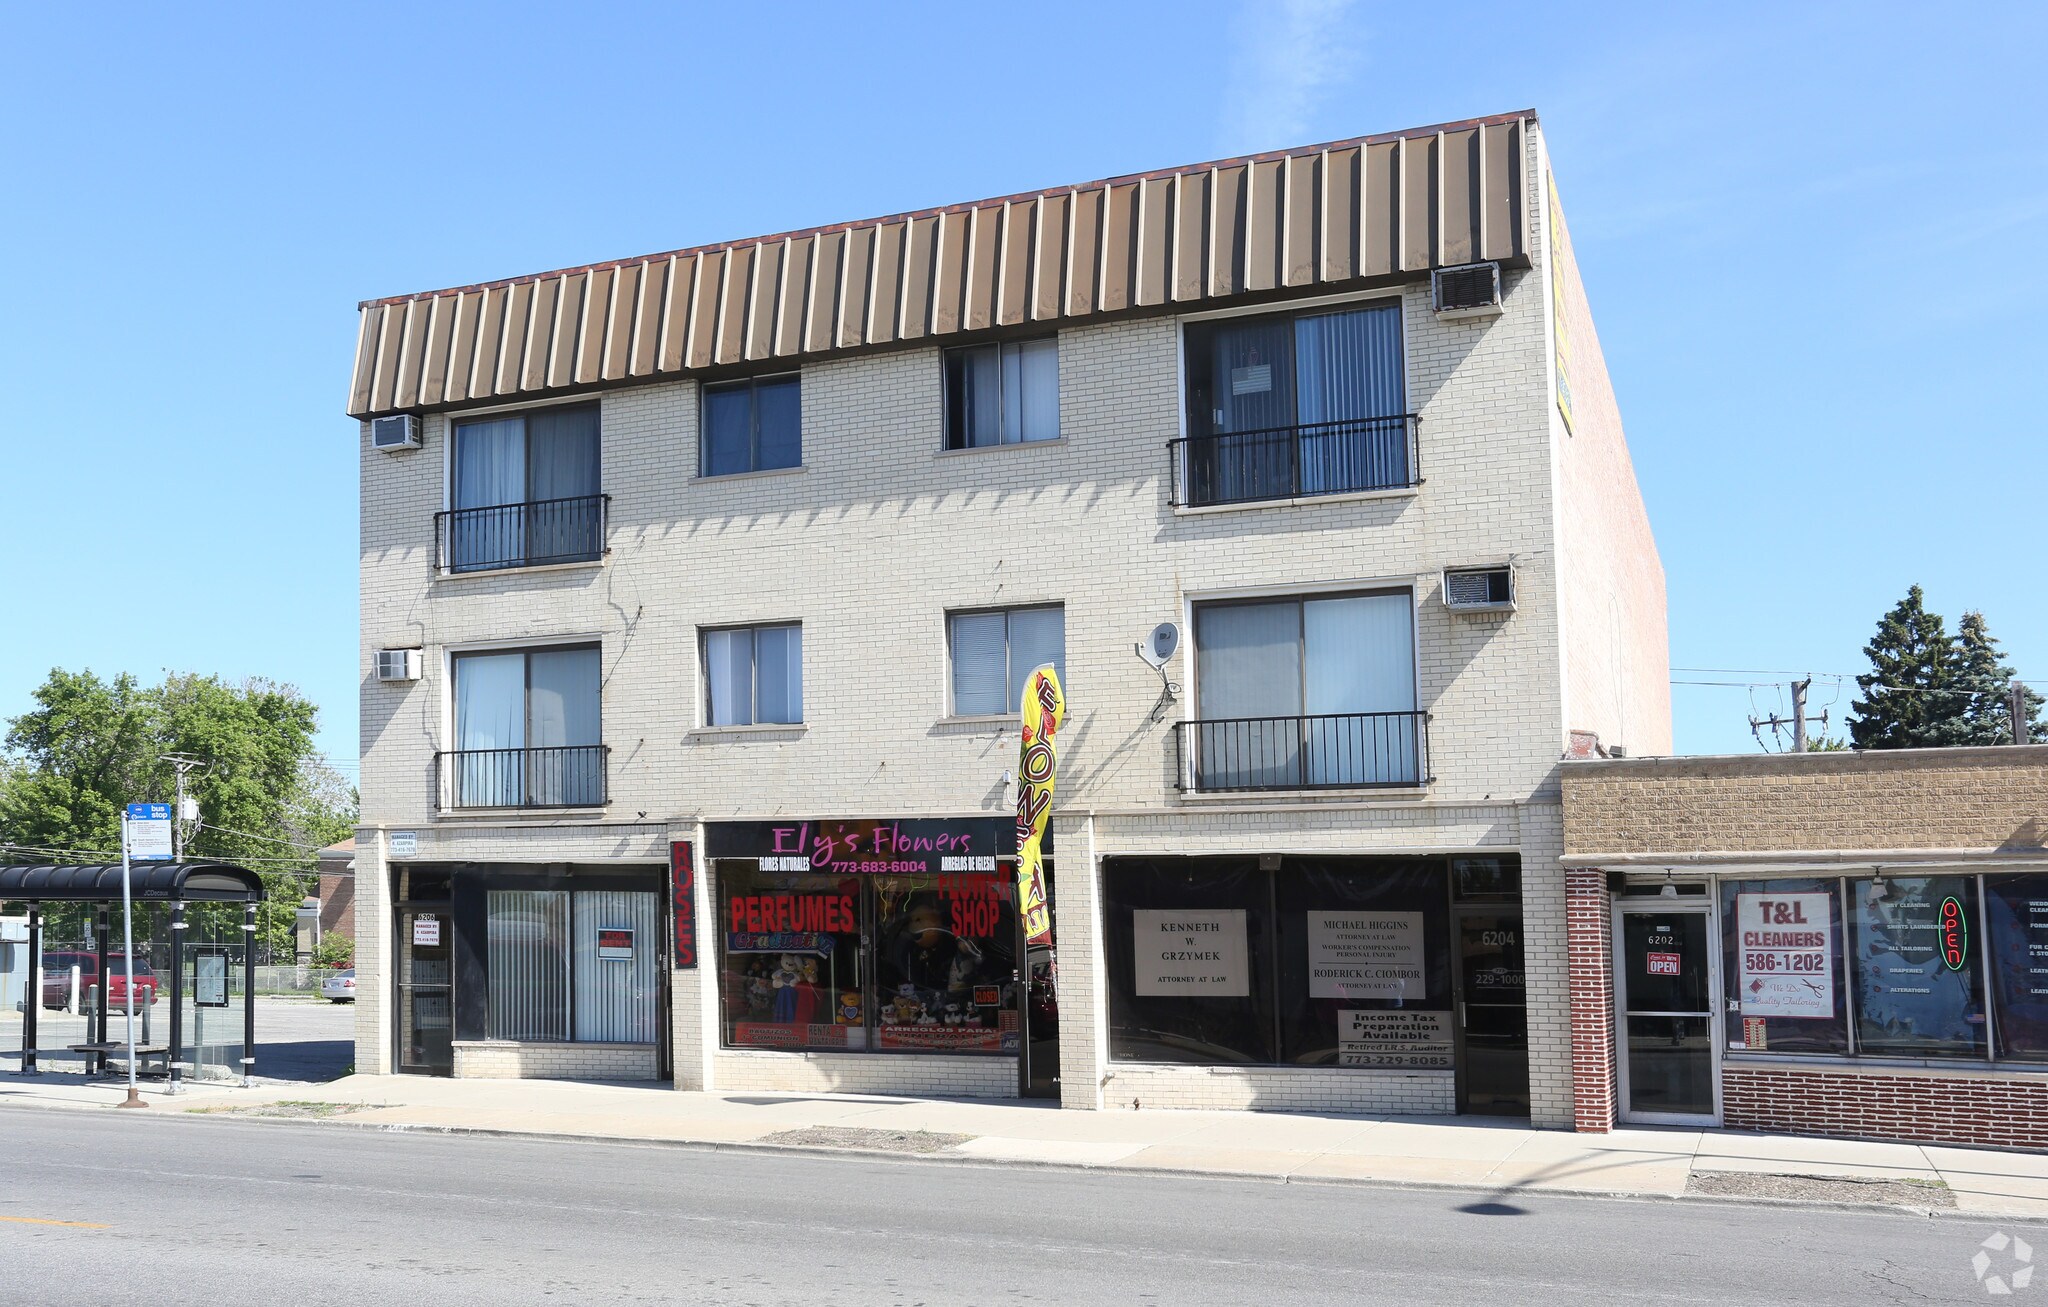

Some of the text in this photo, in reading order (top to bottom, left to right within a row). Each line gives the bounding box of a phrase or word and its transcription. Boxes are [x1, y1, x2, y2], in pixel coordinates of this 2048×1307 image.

[151, 811, 168, 819] stop
[872, 822, 972, 854] Flowers
[771, 822, 860, 867] Ely's
[759, 856, 810, 872] FLORES NATURALES
[831, 861, 927, 873] 773-683-6004
[941, 856, 996, 871] ARREGLOS DE IGLESIA
[938, 865, 1011, 900] FLOWER
[673, 842, 693, 965] ROSES
[418, 913, 435, 921] 6206
[731, 895, 854, 934] PERFUMES
[1759, 900, 1808, 924] T&L
[951, 900, 999, 938] SHOP
[1160, 923, 1220, 932] KENNETH
[1323, 920, 1409, 930] MICHAEL HIGGINS
[606, 931, 626, 939] FOR
[1943, 902, 1961, 963] OPEN
[600, 939, 632, 947] RENT
[735, 932, 834, 953] Graduati
[1185, 937, 1197, 946] W.
[1482, 931, 1516, 946] 6204
[1648, 935, 1674, 944] 6202
[1744, 930, 1825, 947] CLEANERS
[1161, 952, 1221, 960] GRZYMEK
[1650, 961, 1677, 973] OPEN
[1746, 953, 1824, 971] 586-1202
[1314, 969, 1421, 979] RODERICK C. CIOMBOR
[1475, 974, 1525, 984] 229-1000
[1770, 984, 1801, 992] We Do
[975, 991, 998, 1003] CLOSED
[1753, 996, 1820, 1008] Quality Tailoring
[1355, 1013, 1437, 1022] Income Tax
[808, 1025, 830, 1036] RENTA
[1352, 1022, 1440, 1031] Preparation
[885, 1032, 996, 1040] FUNERALES
[1362, 1031, 1431, 1040] Available
[1003, 1040, 1019, 1048] ADT
[1347, 1043, 1383, 1051] Retired
[1346, 1055, 1449, 1065] 773-229-8085
